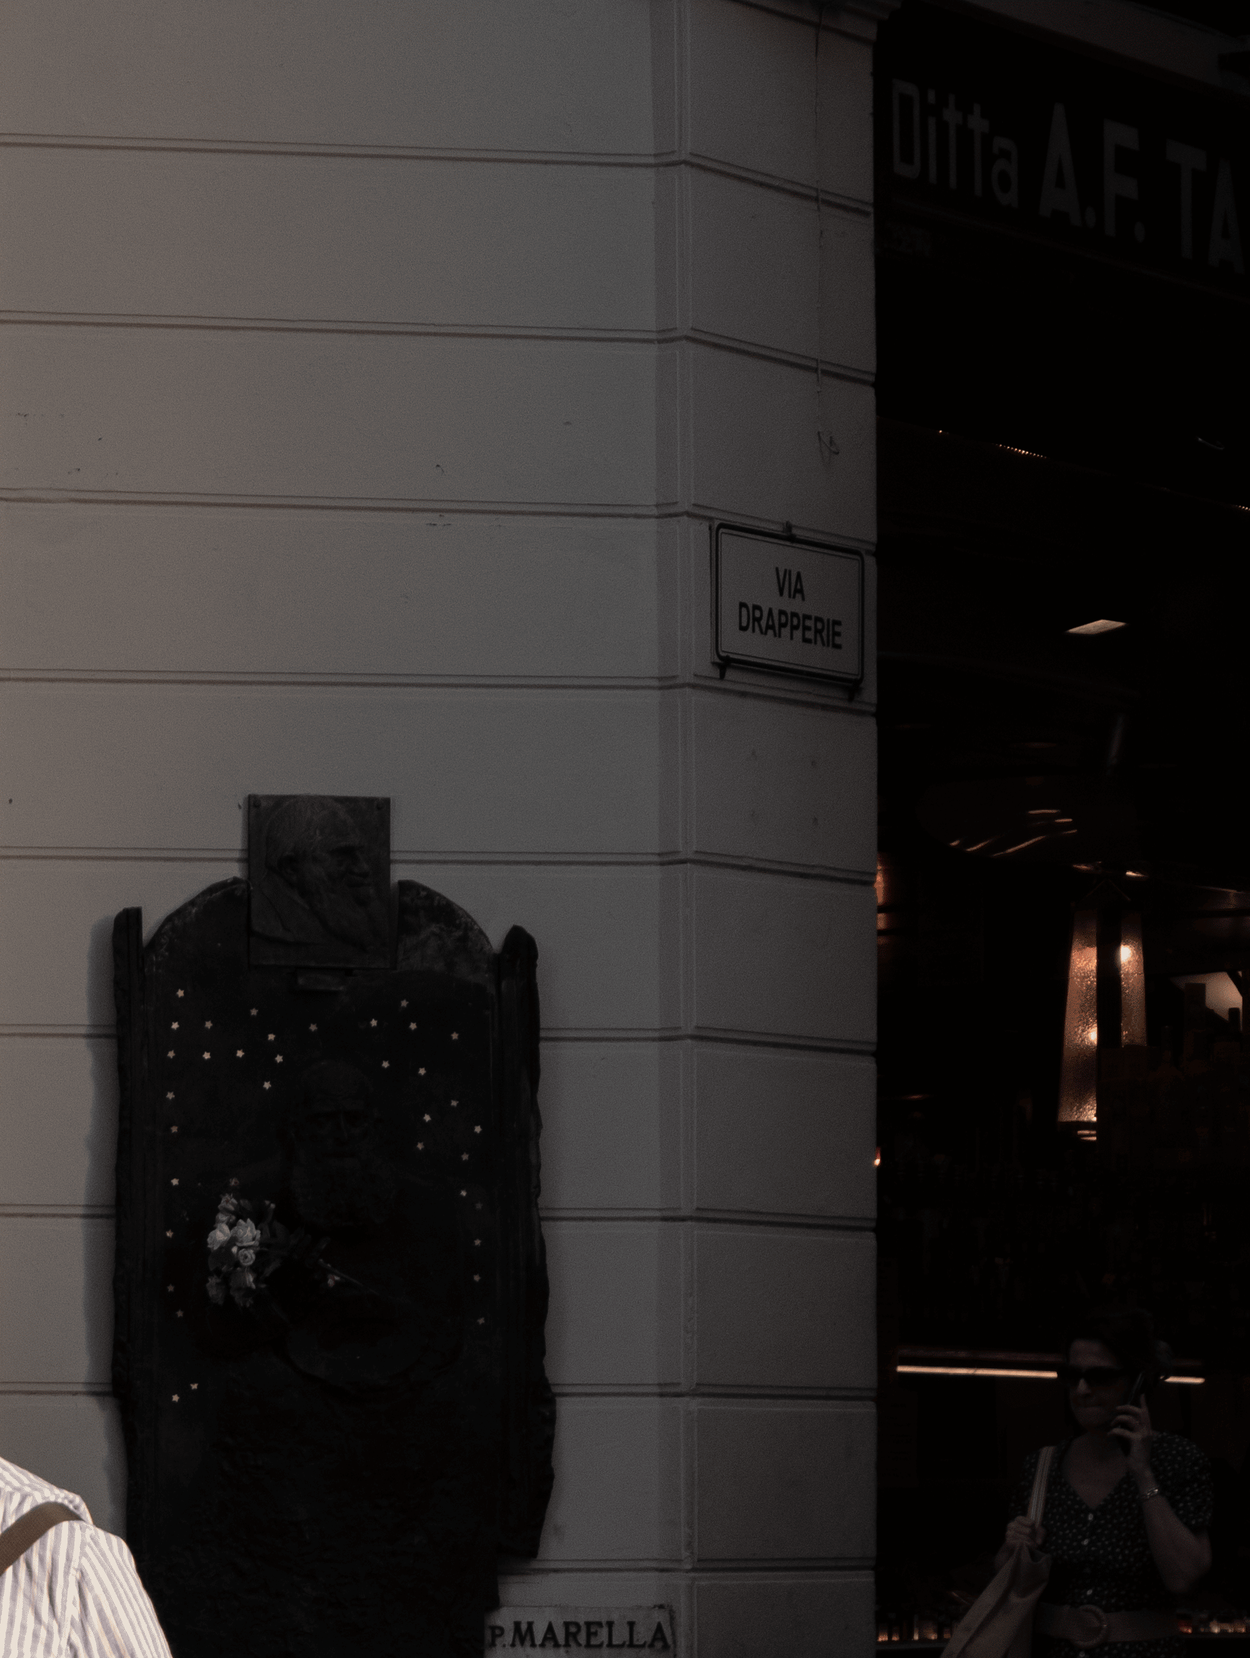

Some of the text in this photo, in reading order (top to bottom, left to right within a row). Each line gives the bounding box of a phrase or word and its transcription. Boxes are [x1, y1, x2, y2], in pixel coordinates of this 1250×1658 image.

[891, 77, 1246, 275] Ditta A.F. TA
[775, 566, 805, 602] VIA
[738, 602, 843, 650] DRAPPERIE
